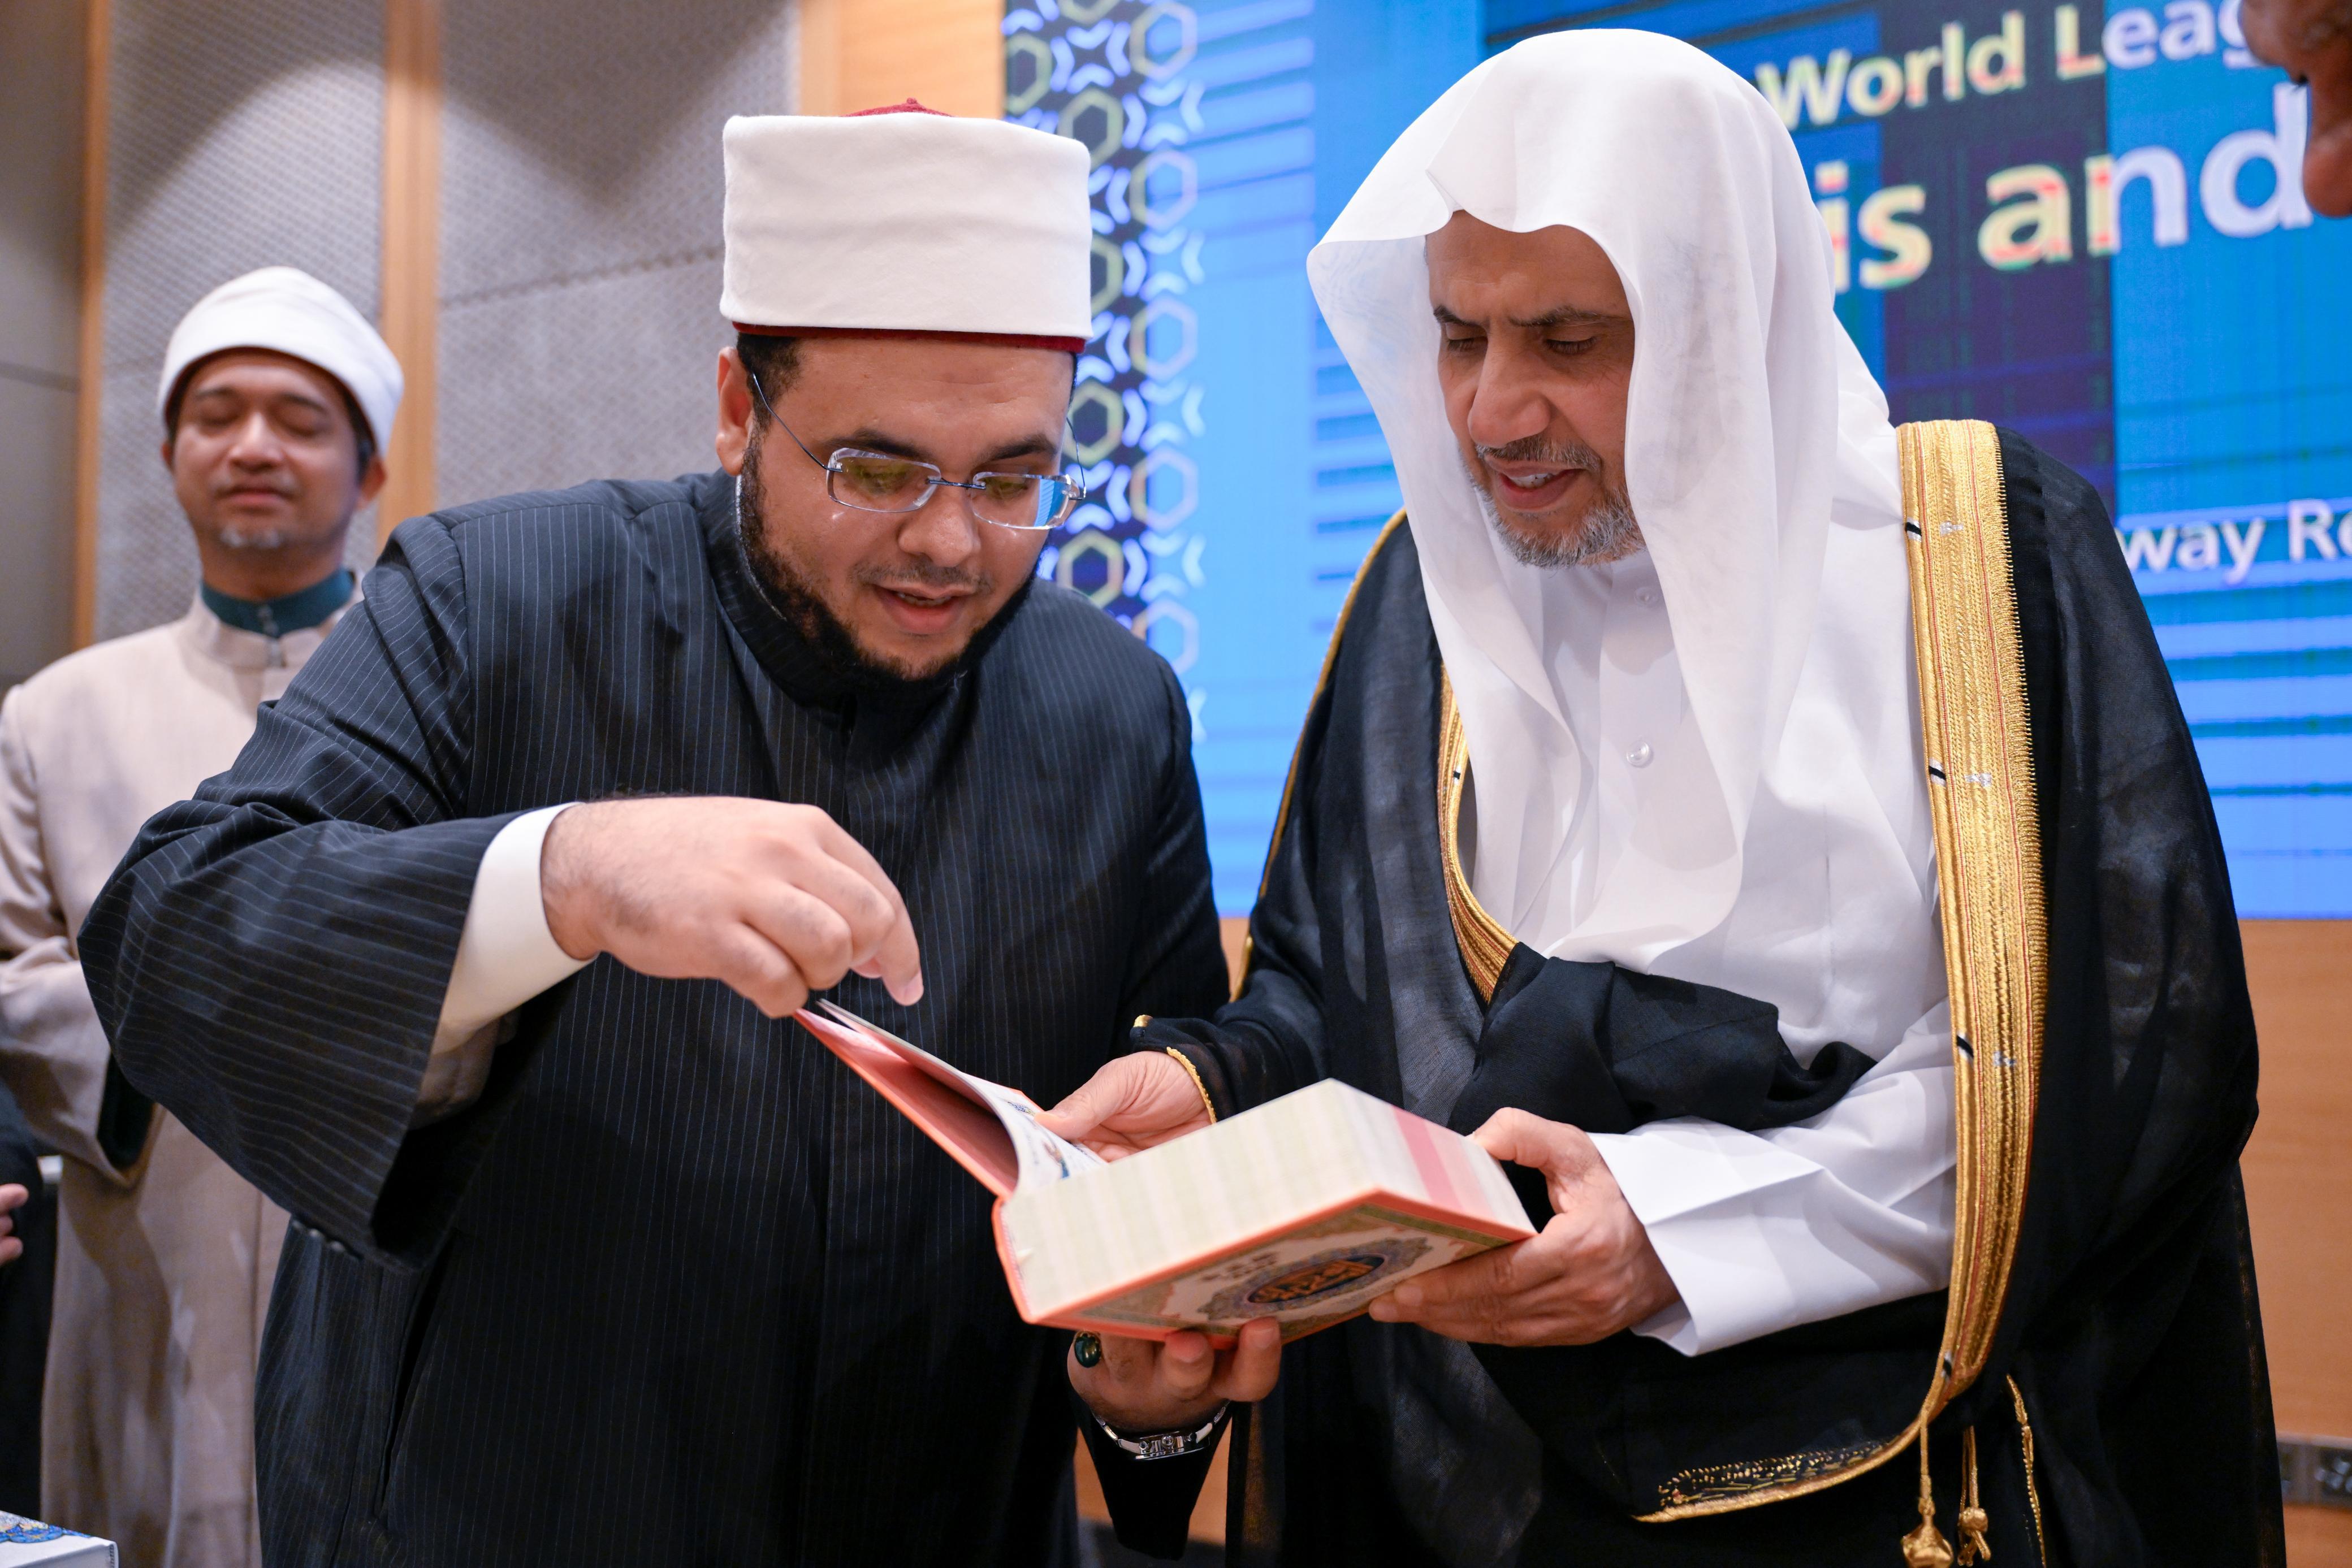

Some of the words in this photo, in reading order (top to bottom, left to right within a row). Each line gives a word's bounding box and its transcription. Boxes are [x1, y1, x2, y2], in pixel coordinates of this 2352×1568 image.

[1755, 11, 2026, 131] World
[1814, 159, 1933, 292] is
[1978, 83, 2314, 271] and
